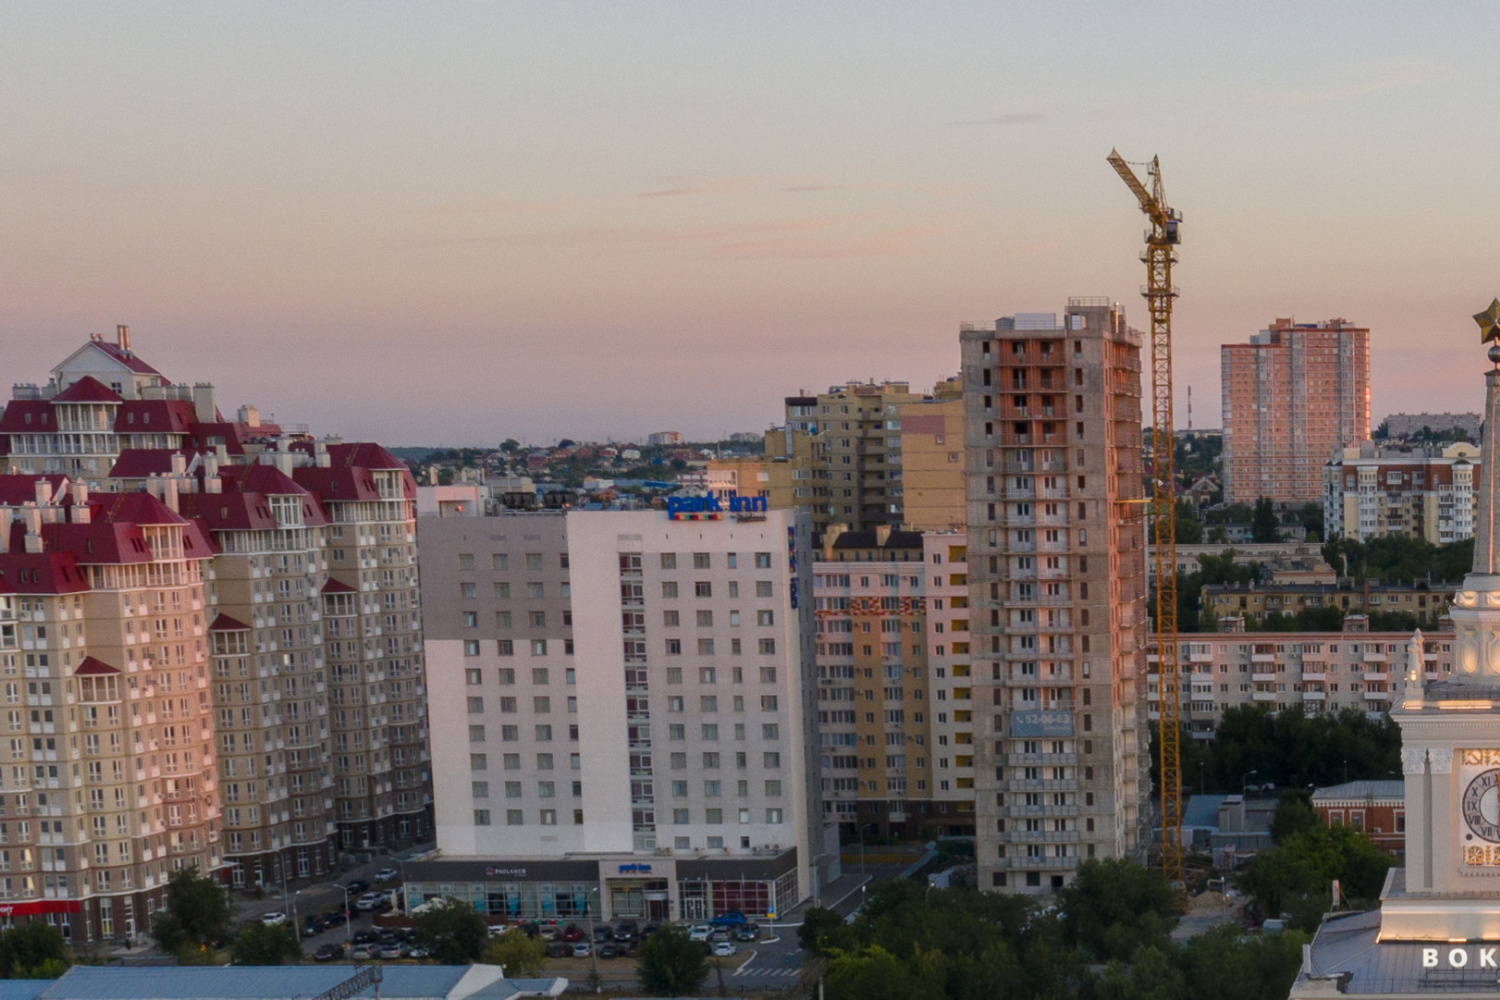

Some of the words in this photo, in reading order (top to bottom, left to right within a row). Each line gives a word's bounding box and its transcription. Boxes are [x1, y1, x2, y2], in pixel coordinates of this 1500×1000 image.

[668, 490, 722, 520] park
[728, 491, 767, 512] inn
[1481, 776, 1491, 787] XI
[1471, 786, 1479, 797] X
[1467, 801, 1477, 811] IX
